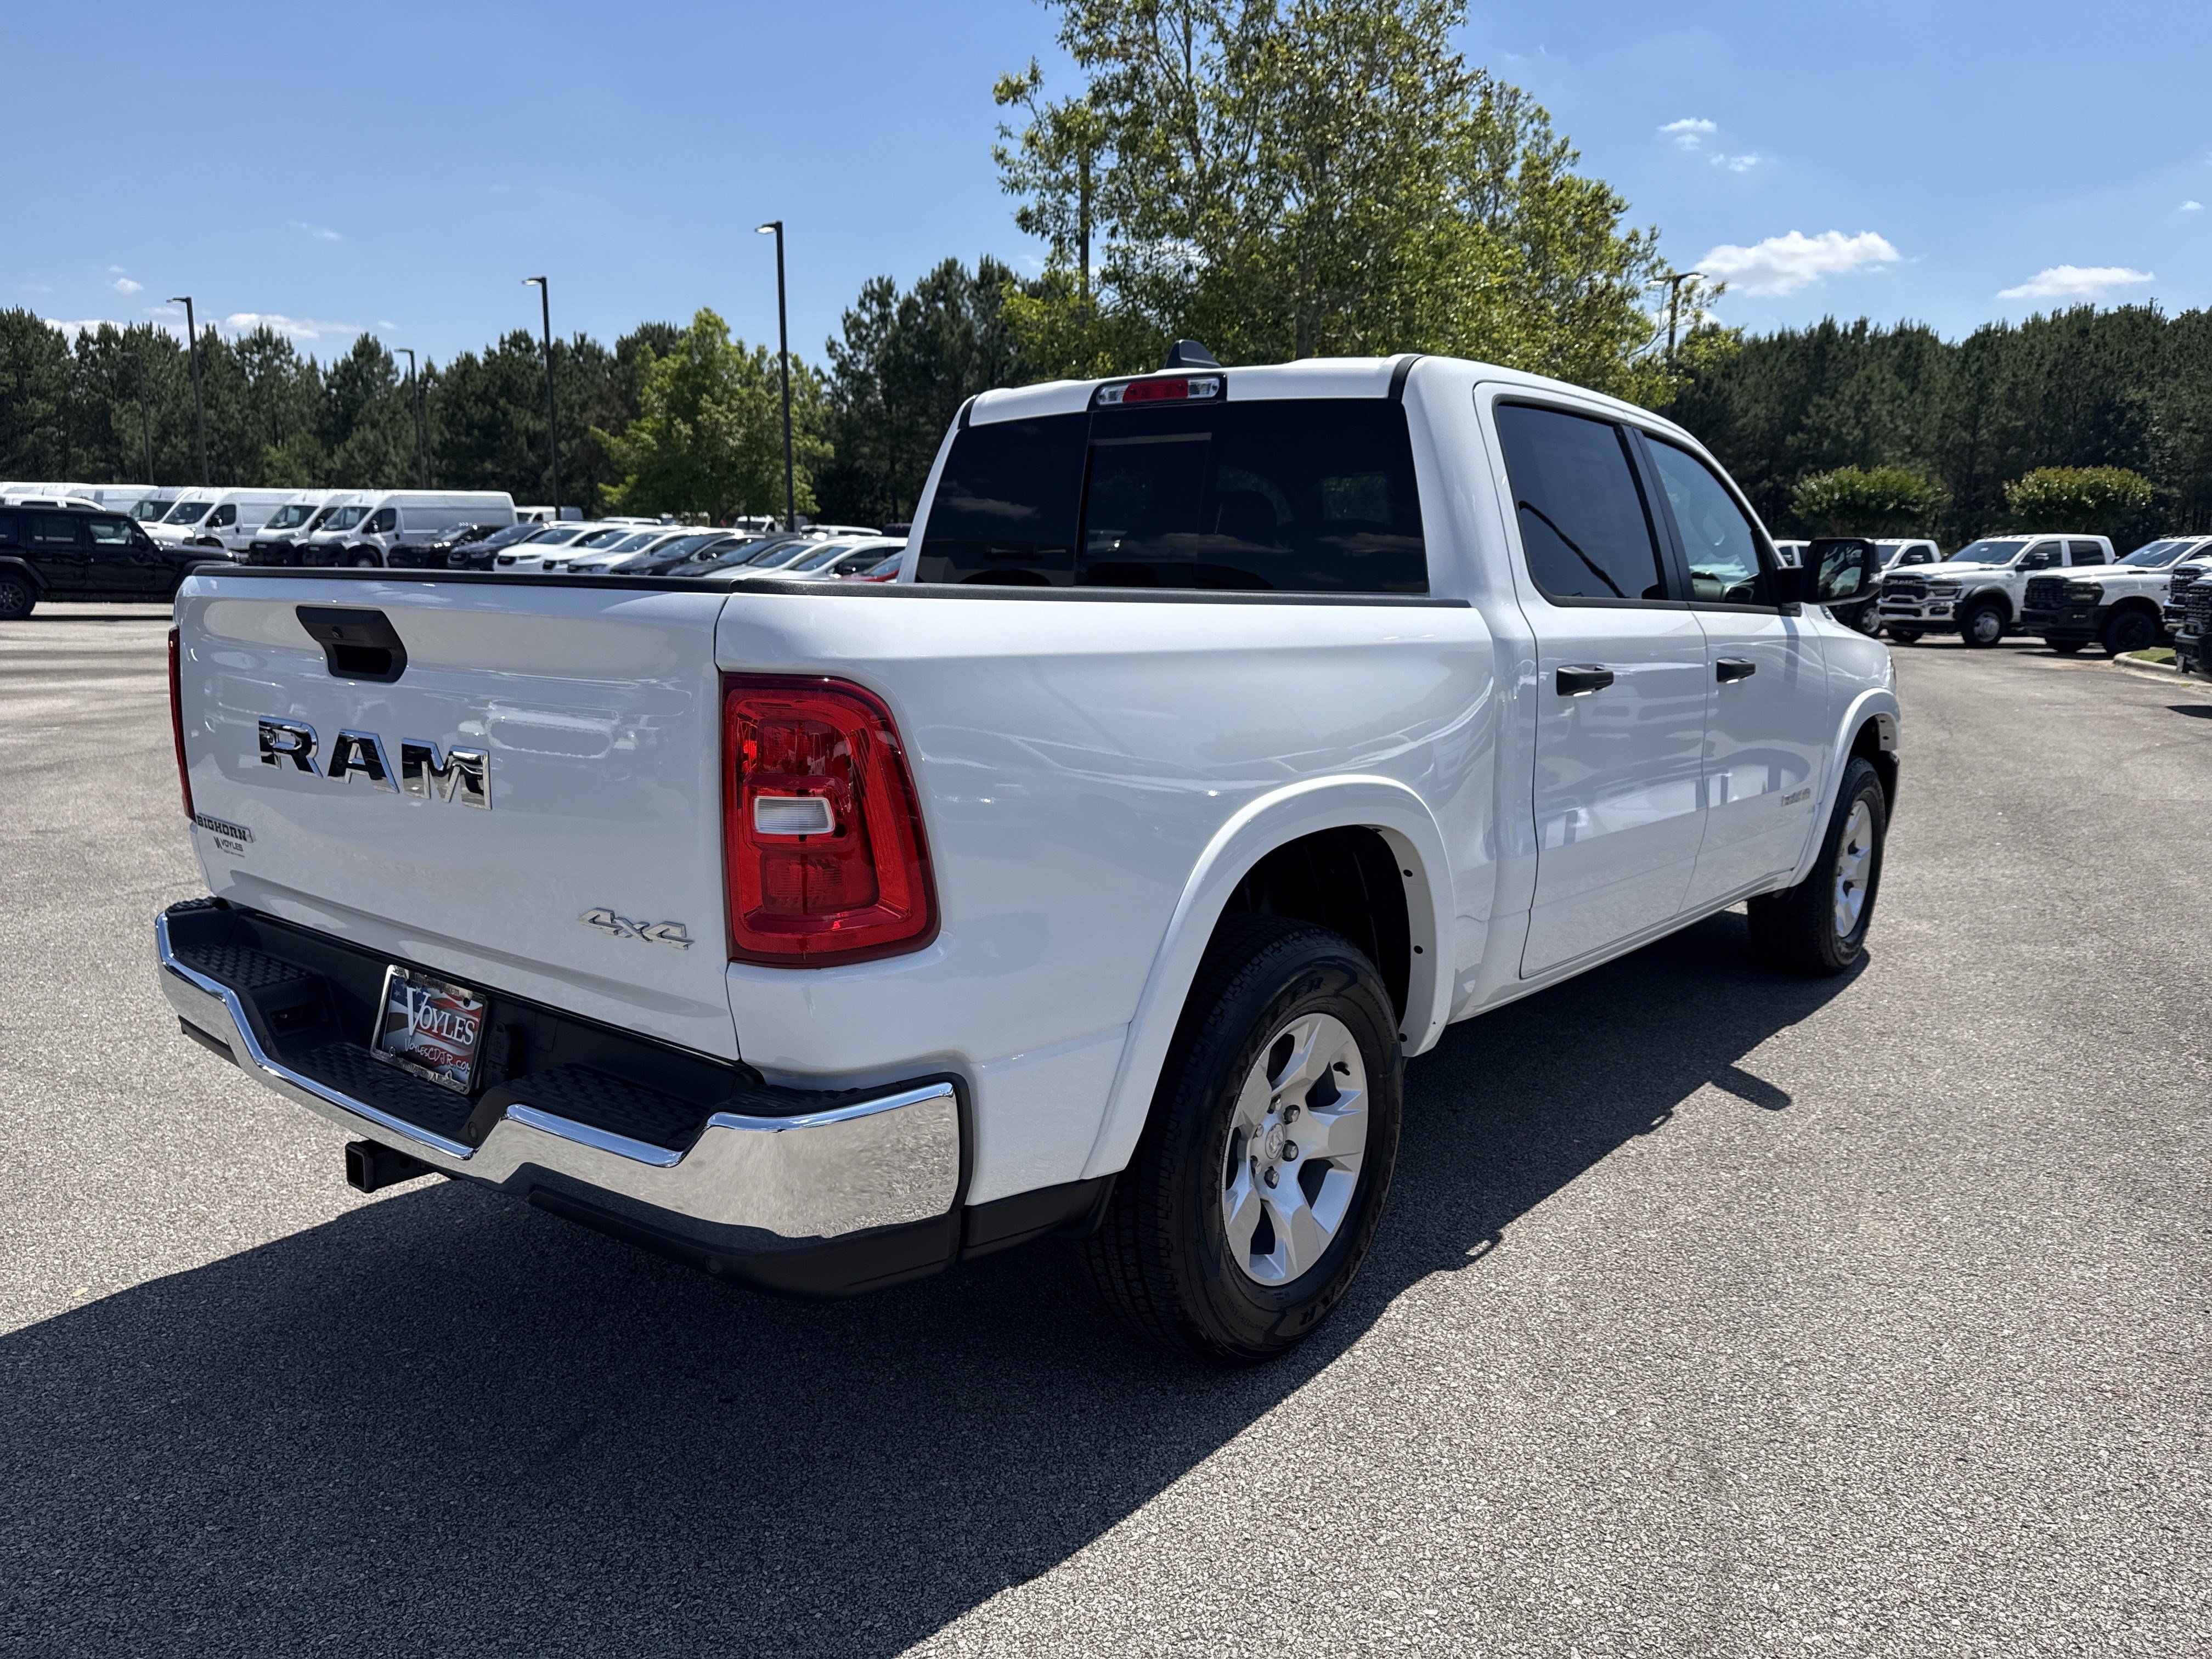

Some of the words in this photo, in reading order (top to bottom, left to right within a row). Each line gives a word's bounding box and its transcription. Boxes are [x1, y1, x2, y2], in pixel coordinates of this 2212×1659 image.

[259, 715, 492, 810] RAM
[196, 814, 247, 842] BIGHORN
[220, 838, 244, 852] VOYLES
[407, 986, 475, 1045] VOYLES
